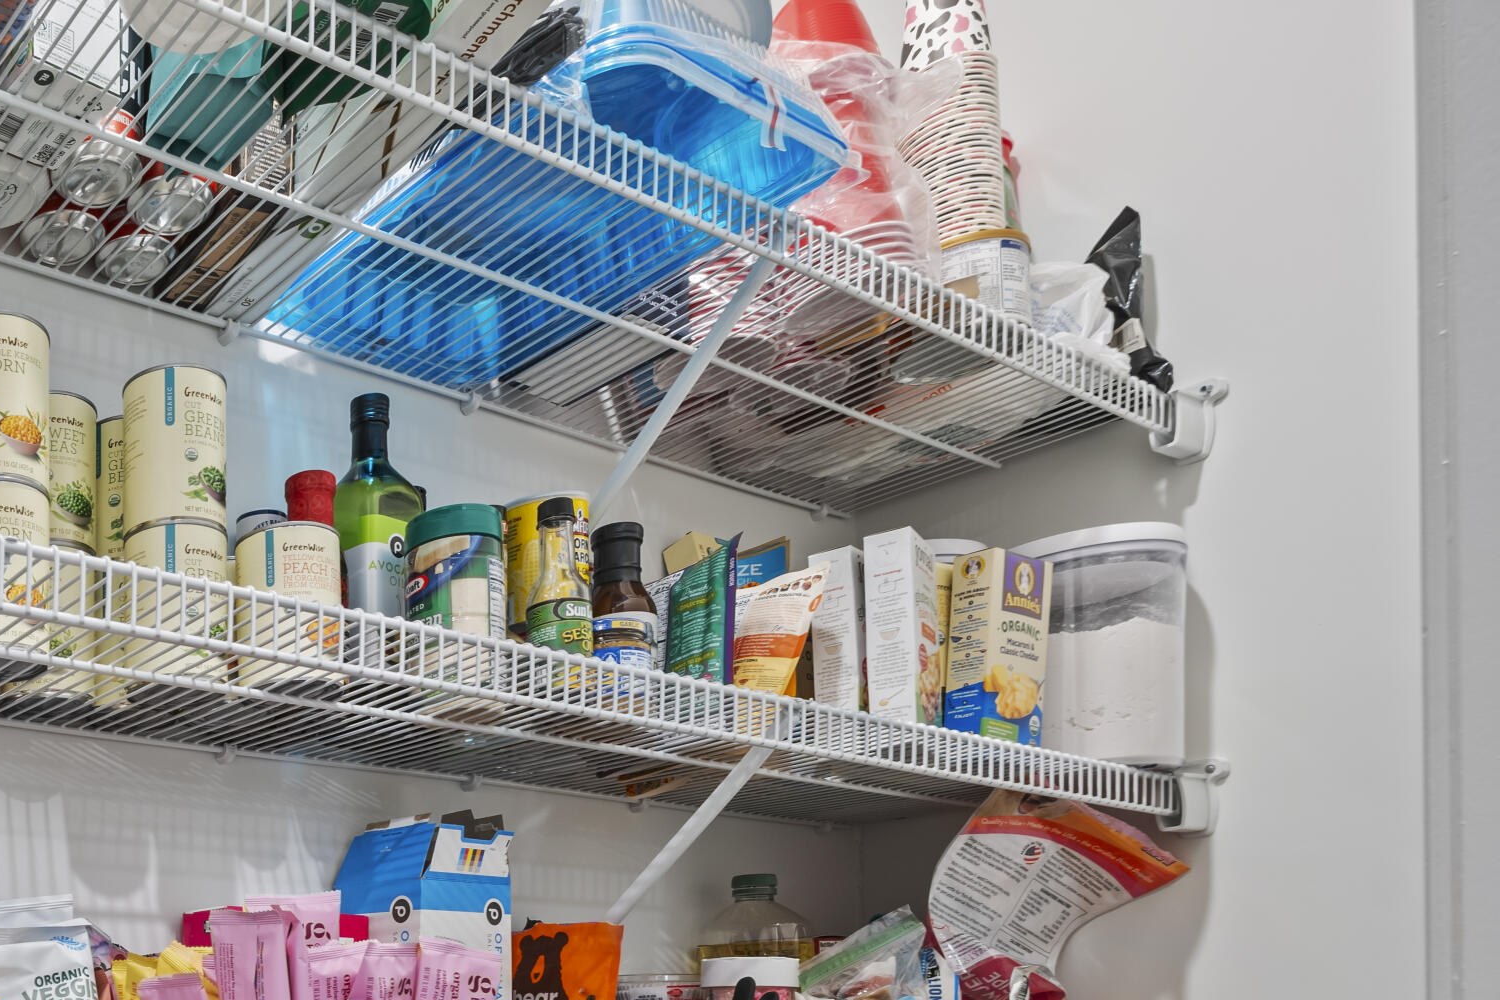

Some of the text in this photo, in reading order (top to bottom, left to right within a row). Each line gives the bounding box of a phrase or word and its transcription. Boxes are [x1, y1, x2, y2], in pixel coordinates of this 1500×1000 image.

[184, 386, 223, 405] GreenWise
[184, 410, 225, 429] GREEN
[185, 423, 226, 448] BEANS
[185, 543, 223, 561] GreenWise
[283, 541, 325, 553] GreenWise
[283, 562, 328, 576] PEACH
[1004, 592, 1040, 615] Annie's
[1001, 620, 1041, 642] ORGANIC
[1006, 638, 1031, 649] Macaroni
[1000, 646, 1039, 662] Classic Cheddar
[981, 817, 1004, 827] Quality
[34, 966, 90, 988] ORGANIC
